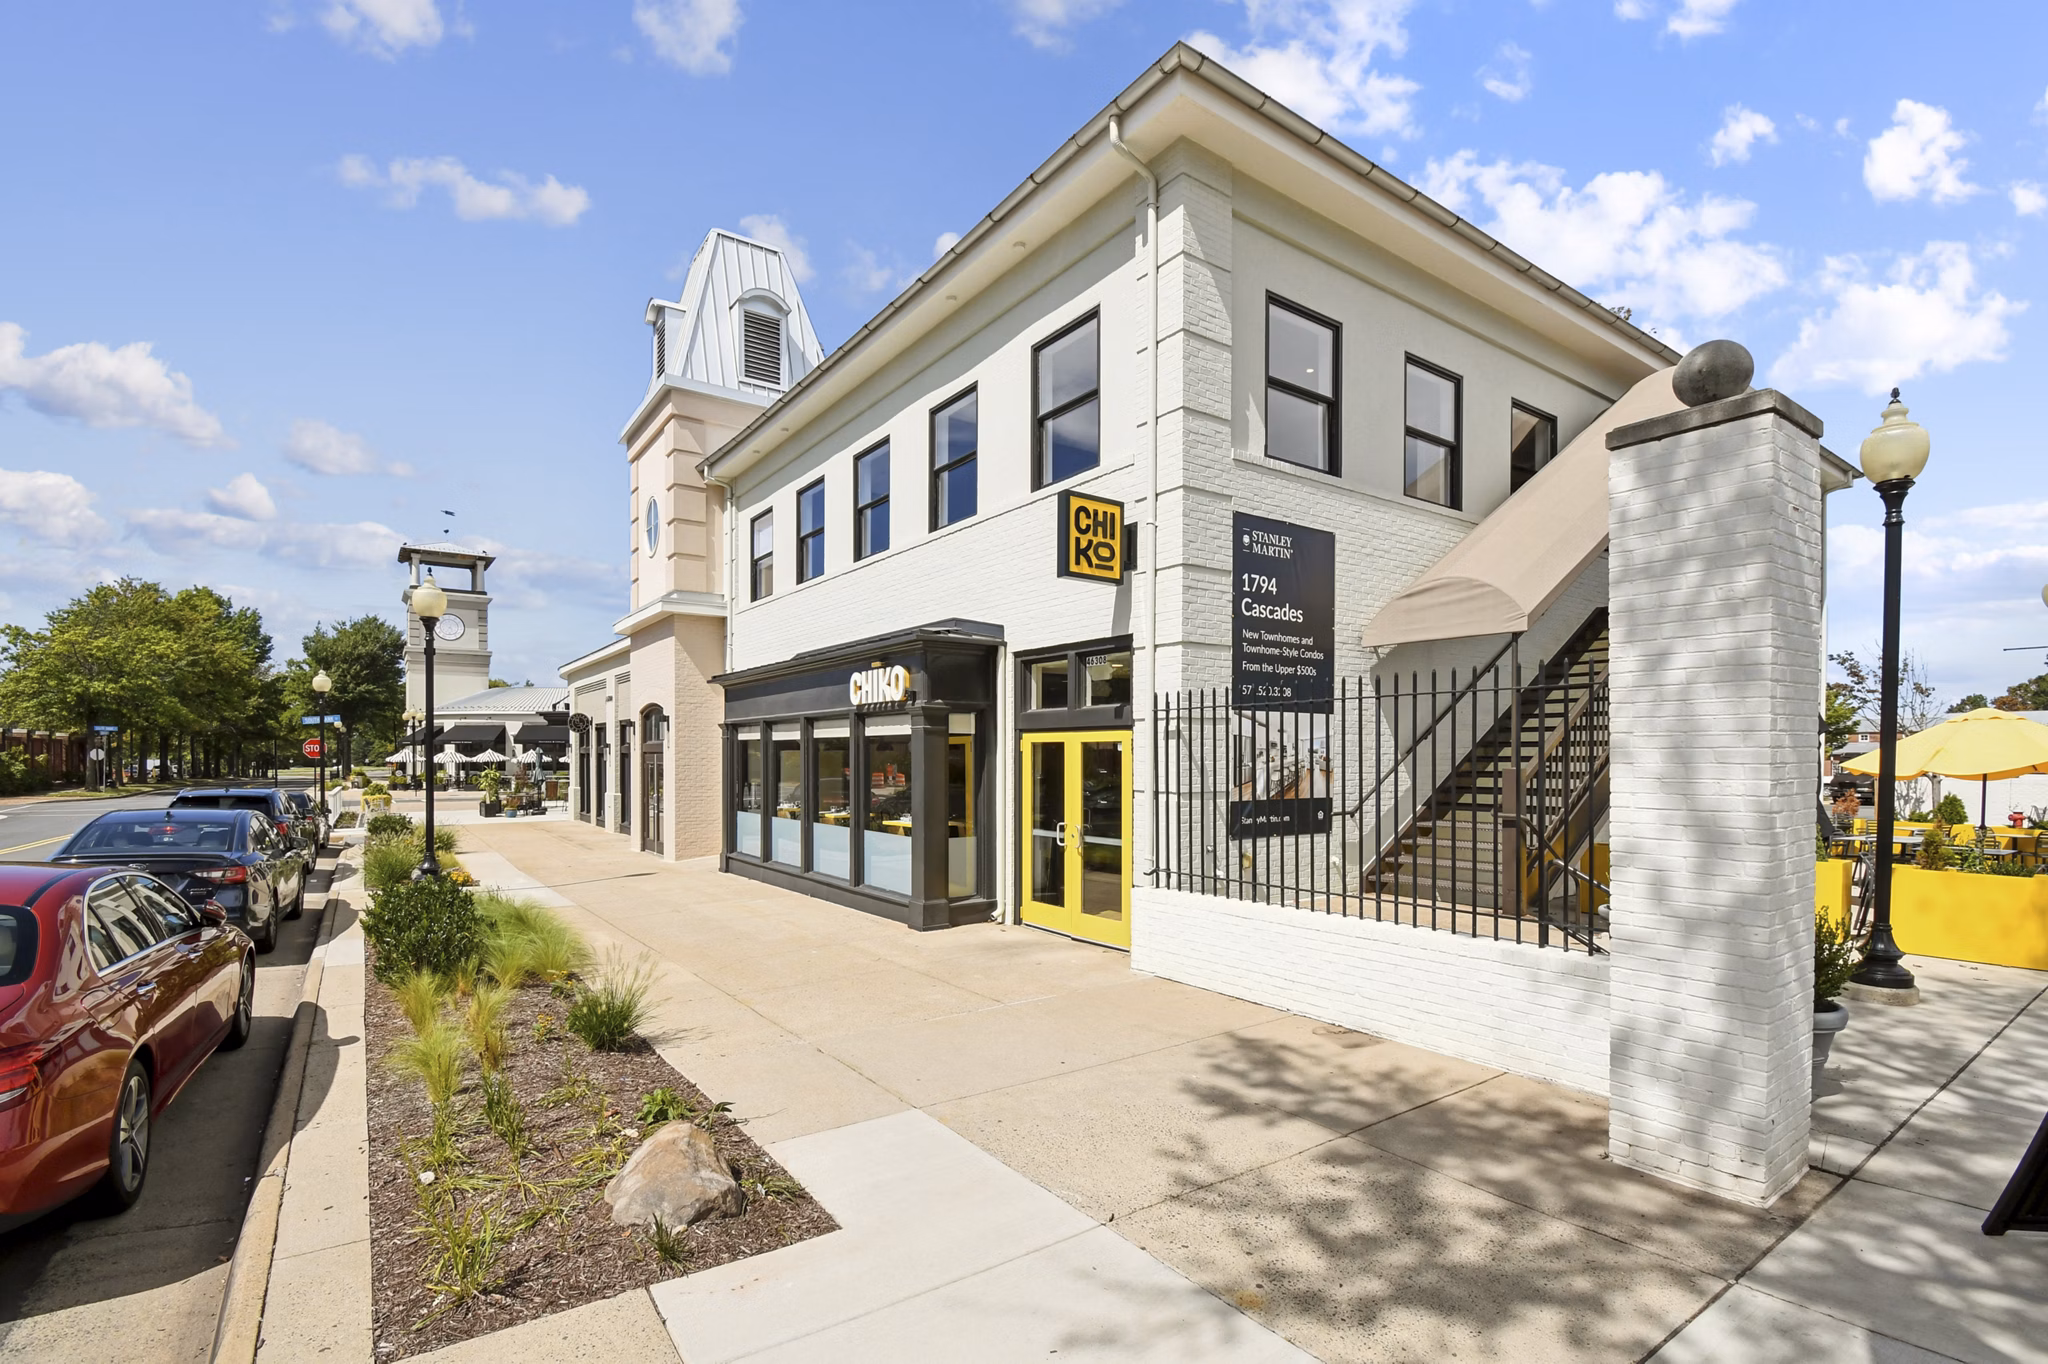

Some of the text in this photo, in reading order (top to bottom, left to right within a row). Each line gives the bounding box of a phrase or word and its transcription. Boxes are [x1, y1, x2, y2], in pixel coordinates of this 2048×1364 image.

[1074, 505, 1116, 540] CHI
[1252, 530, 1292, 547] STANLEY
[1074, 536, 1116, 571] KO
[1252, 542, 1291, 559] MARTIN
[1241, 572, 1277, 595] 1794
[1241, 597, 1304, 622] Cascades
[1242, 628, 1313, 645] New Townhomes and
[1242, 642, 1324, 660] Townhome-Style Condos
[1086, 655, 1107, 666] 46308
[1242, 661, 1317, 676] From the Upper $500s
[850, 664, 906, 706] CHIKO
[305, 744, 320, 752] STO
